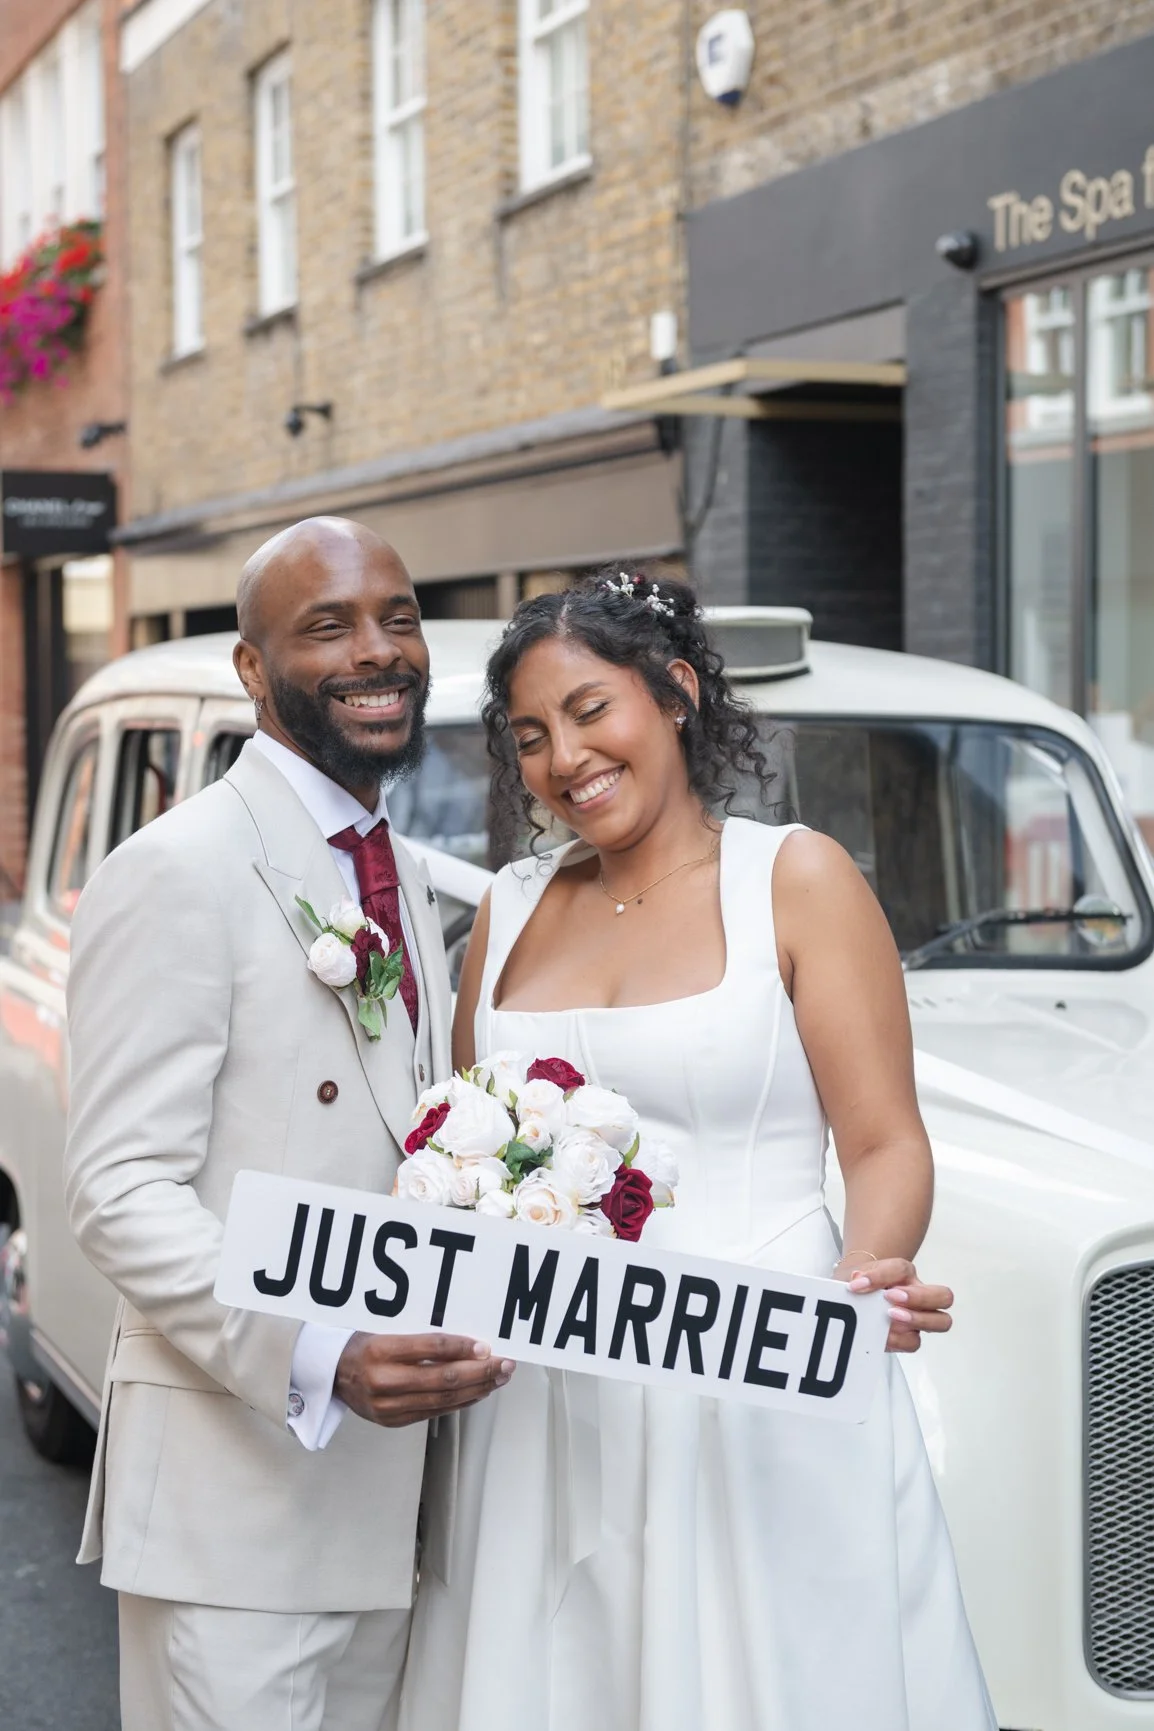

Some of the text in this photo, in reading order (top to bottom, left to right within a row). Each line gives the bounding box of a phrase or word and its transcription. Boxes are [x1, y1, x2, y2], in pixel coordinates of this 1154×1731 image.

[987, 190, 1053, 253] The
[1059, 168, 1135, 241] Spa
[253, 1202, 858, 1399] JUST MARRIED
